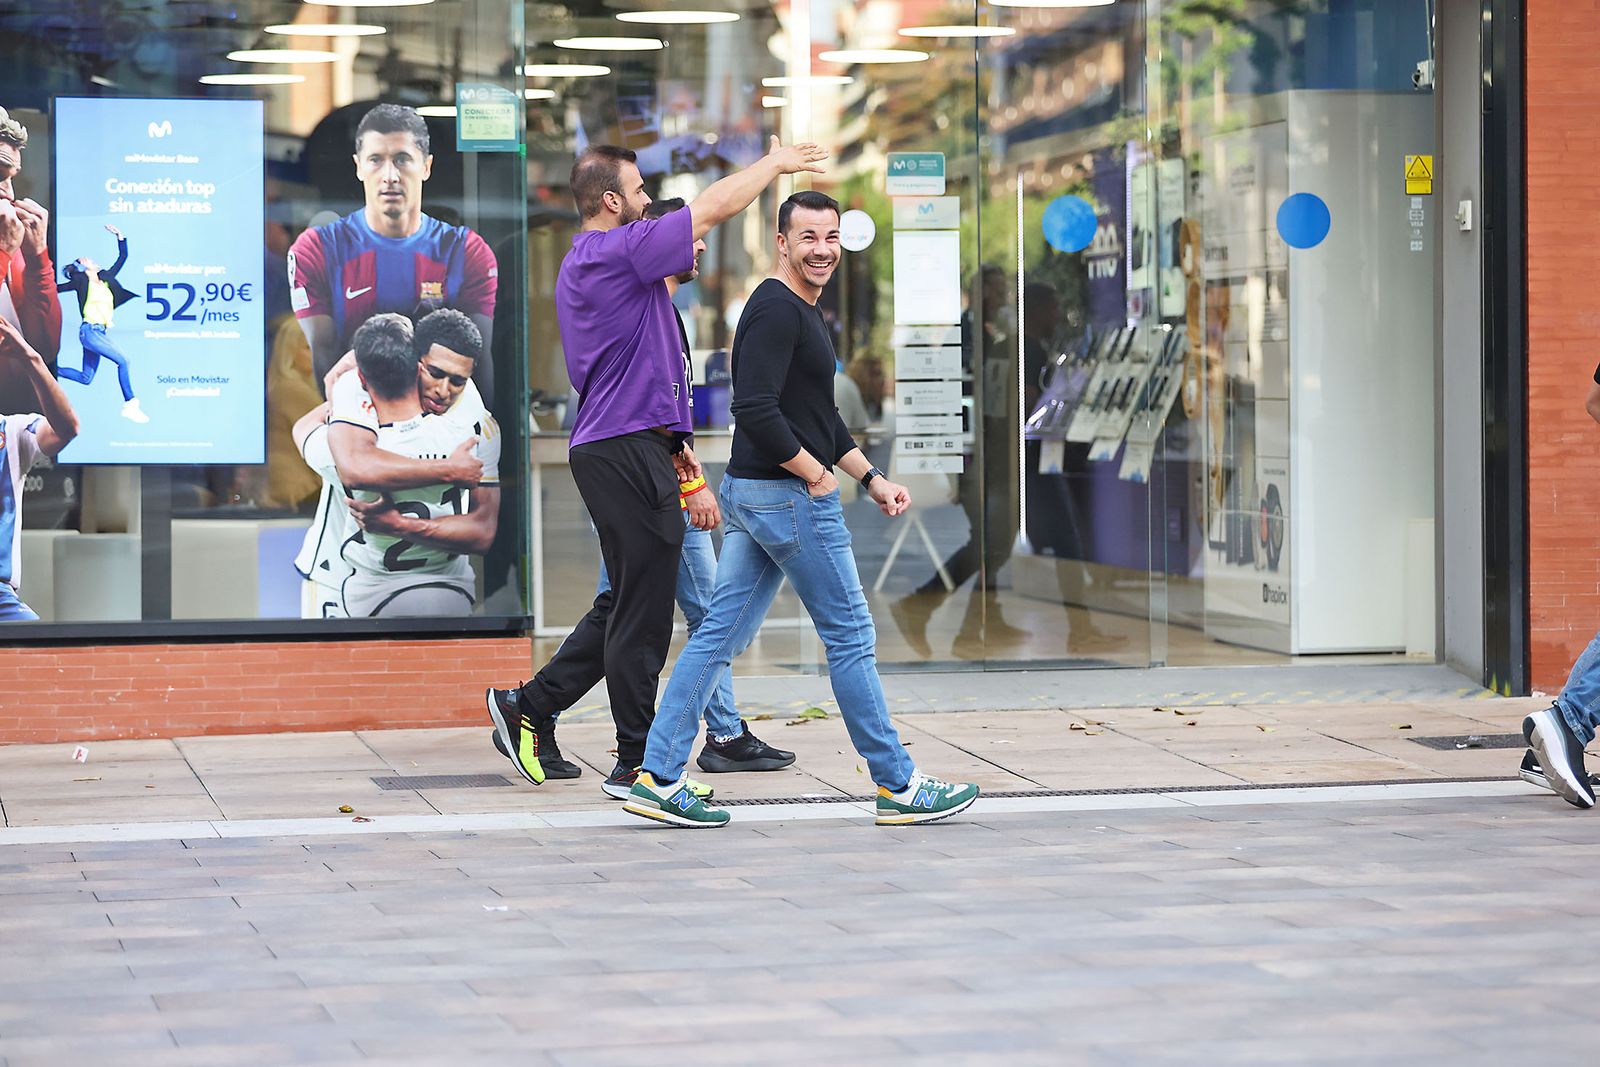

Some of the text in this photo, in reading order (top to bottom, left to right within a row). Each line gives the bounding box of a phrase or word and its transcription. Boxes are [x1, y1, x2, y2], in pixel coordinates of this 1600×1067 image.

[105, 177, 216, 199] Conexión top
[109, 197, 212, 214] sin ataduras
[200, 308, 240, 325] /mes
[157, 375, 176, 384] Solo
[191, 375, 229, 384] Movistar
